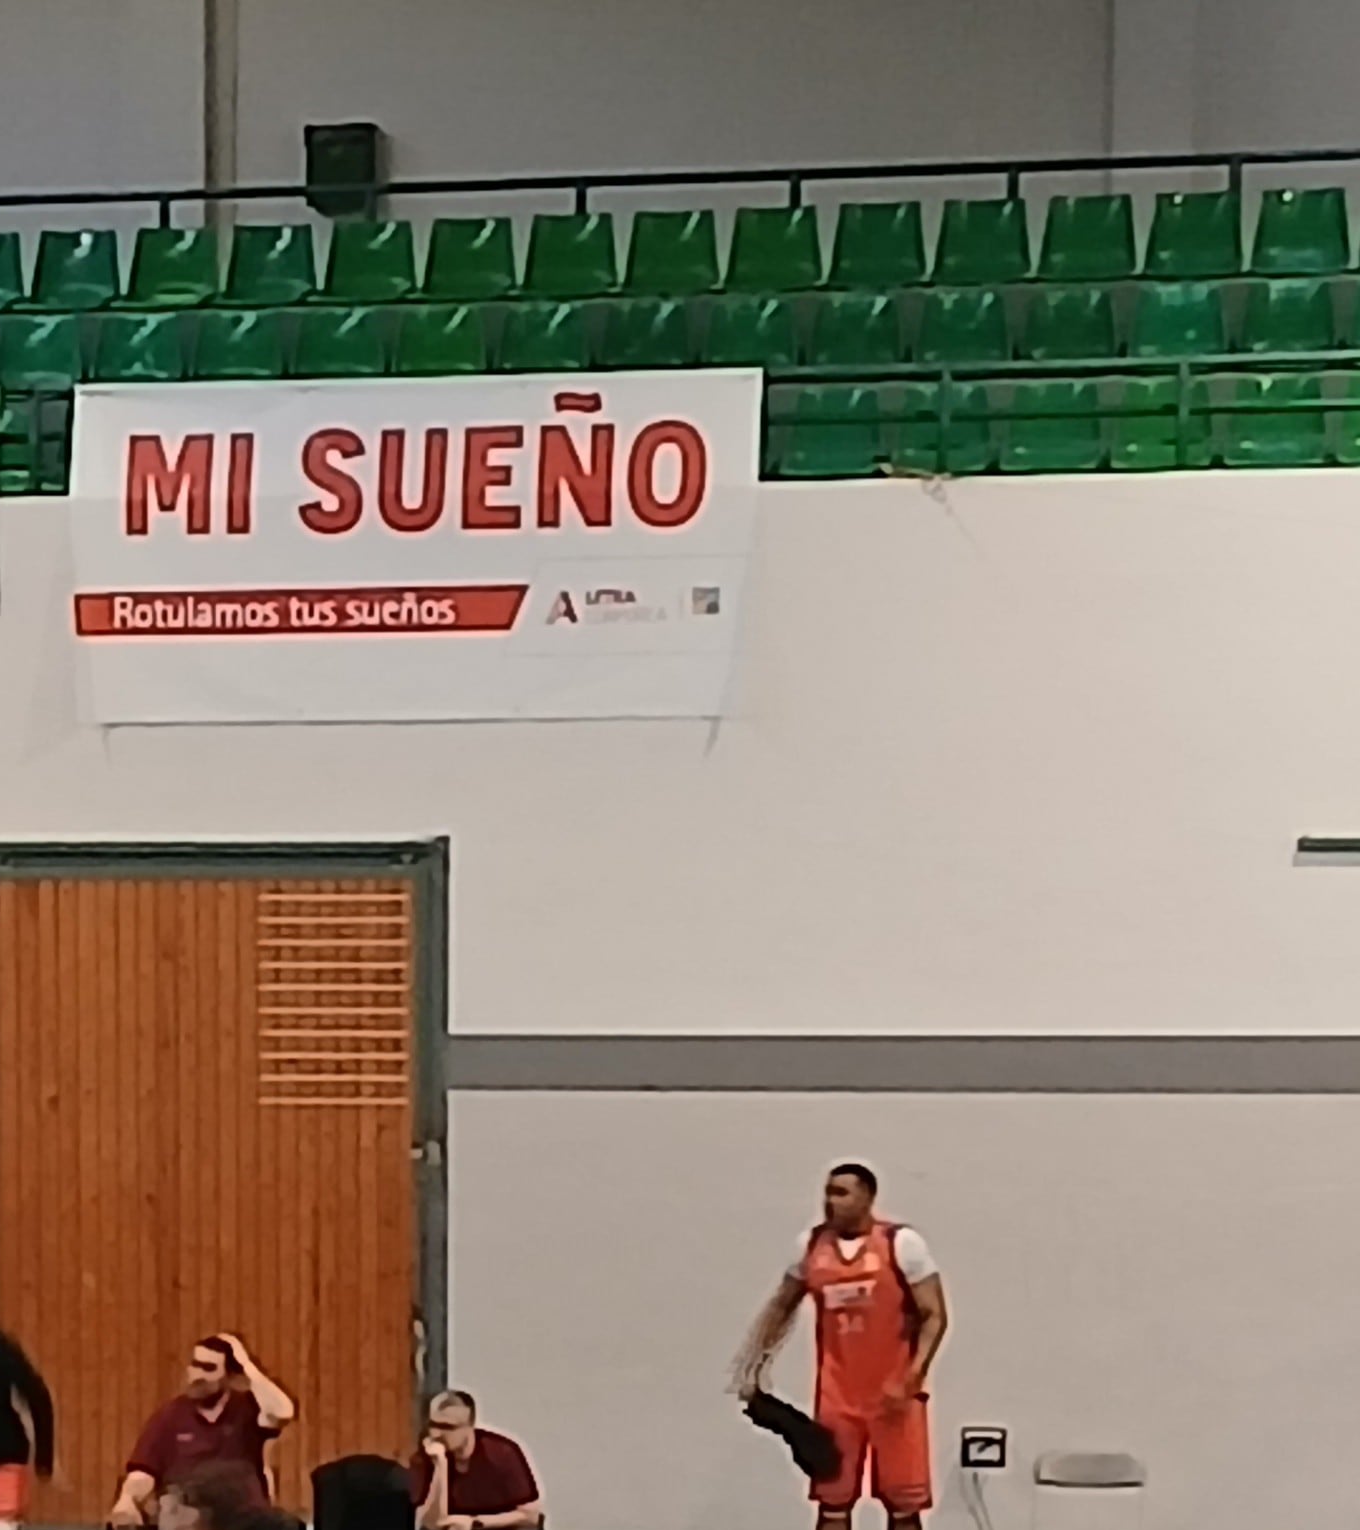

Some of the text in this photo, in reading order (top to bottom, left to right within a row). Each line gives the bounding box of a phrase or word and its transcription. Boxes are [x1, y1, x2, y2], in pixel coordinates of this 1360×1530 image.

[125, 391, 707, 536] MI SUEÑO
[113, 592, 456, 629] Rotulamos tus sueños
